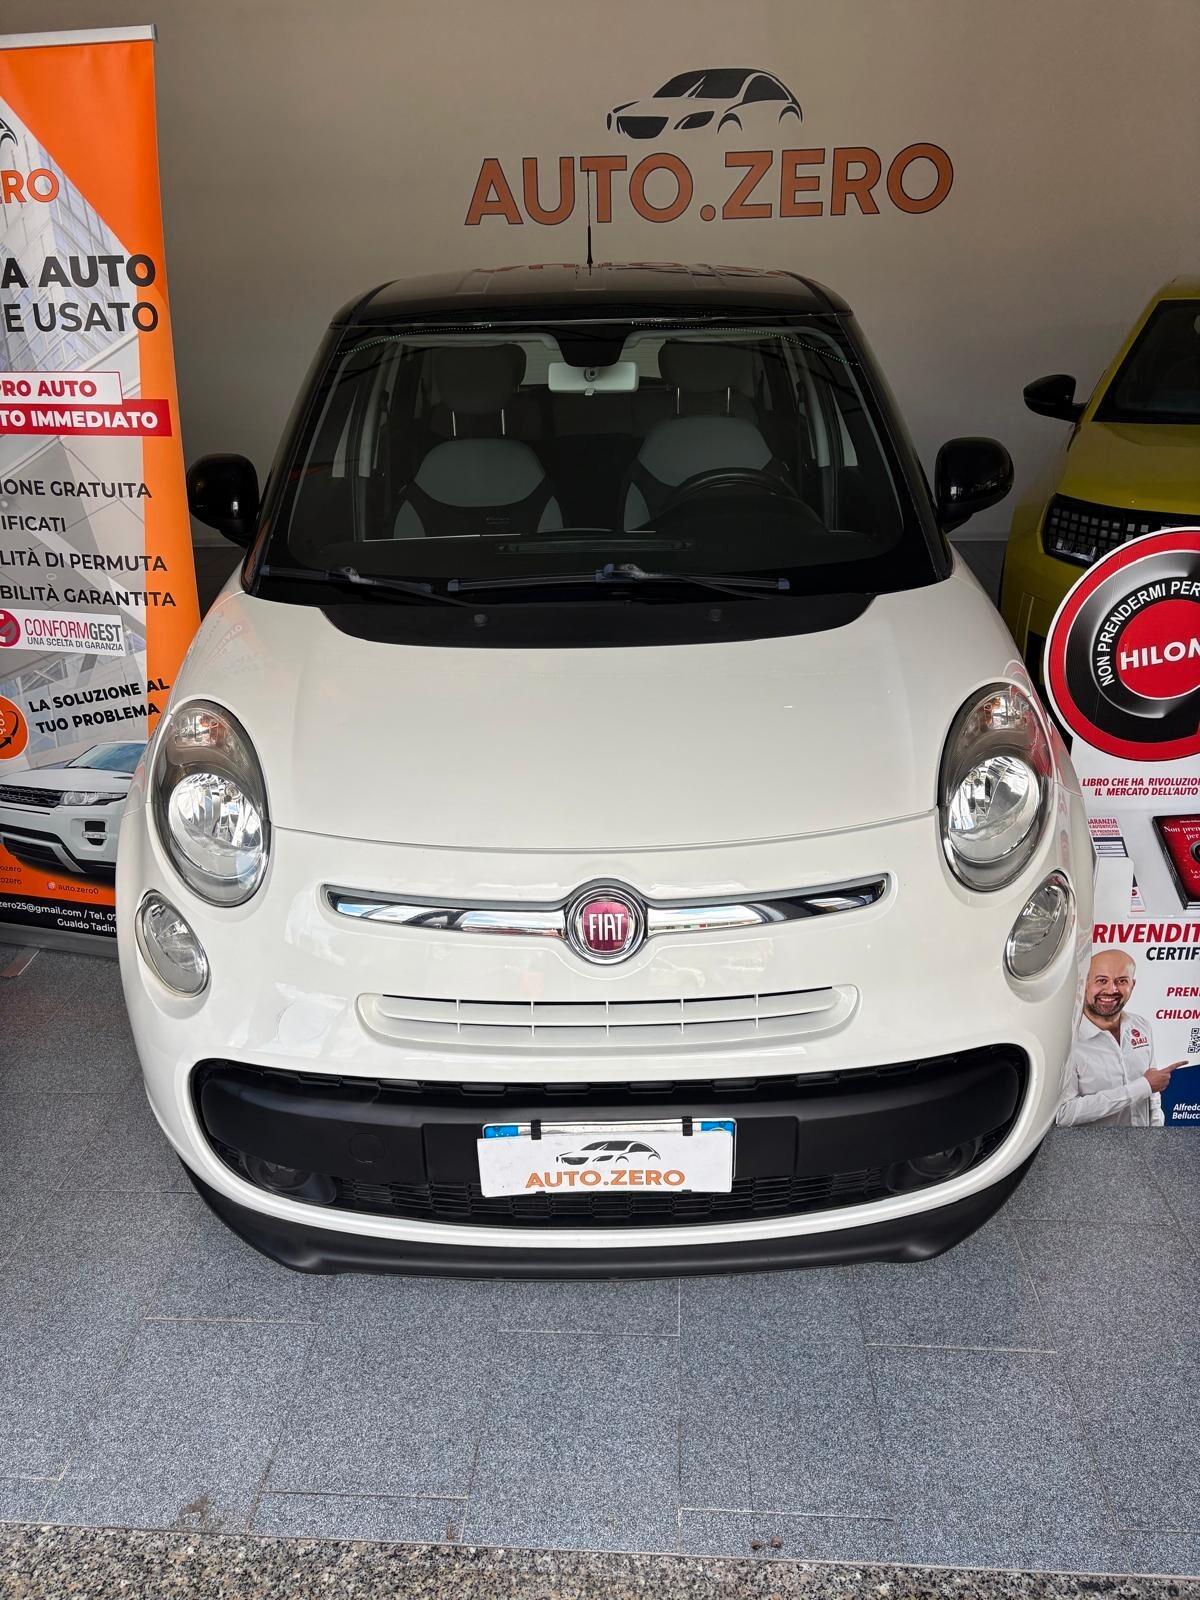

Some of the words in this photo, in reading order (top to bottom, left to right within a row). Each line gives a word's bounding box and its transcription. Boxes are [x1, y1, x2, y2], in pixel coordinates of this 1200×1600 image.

[464, 142, 954, 226] AUTO.ZERO
[1, 257, 28, 289] A
[39, 253, 156, 288] AUTO
[4, 303, 24, 332] E
[33, 302, 159, 332] USATO
[0, 379, 32, 397] RO
[38, 380, 97, 397] AUTO
[30, 410, 158, 429] IMMEDIATO
[50, 480, 152, 499] GRATUITA
[1, 515, 66, 532] IFICATI
[45, 552, 64, 568] DI
[70, 554, 168, 572] PERMUTA
[0, 583, 59, 601] BILITÀ
[63, 588, 176, 607] GARANTITA
[1097, 583, 1166, 652] PRENDERMI
[25, 618, 121, 643] CONFORMGEST
[27, 637, 46, 645] UNA
[46, 638, 74, 648] SCELTA
[84, 642, 124, 651] GARANZIA
[1096, 655, 1115, 687] NON
[28, 699, 51, 713] LA
[53, 682, 141, 709] SOLUZIONE
[147, 678, 170, 694] AL
[36, 719, 69, 734] TUO
[72, 702, 160, 728] PROBLEMA
[1082, 778, 1109, 787] LIBRO
[1111, 778, 1130, 786] CHE
[1131, 778, 1144, 786] HA
[1094, 788, 1103, 796] IL
[1106, 787, 1149, 796] MERCATO
[1151, 787, 1199, 796] DELL'AUTO
[57, 918, 89, 929] Gualdo
[89, 911, 105, 920] Tel.
[589, 913, 625, 942] FIAT
[1166, 986, 1200, 997] PREN
[525, 1169, 685, 1189] AUTO.ZERO
